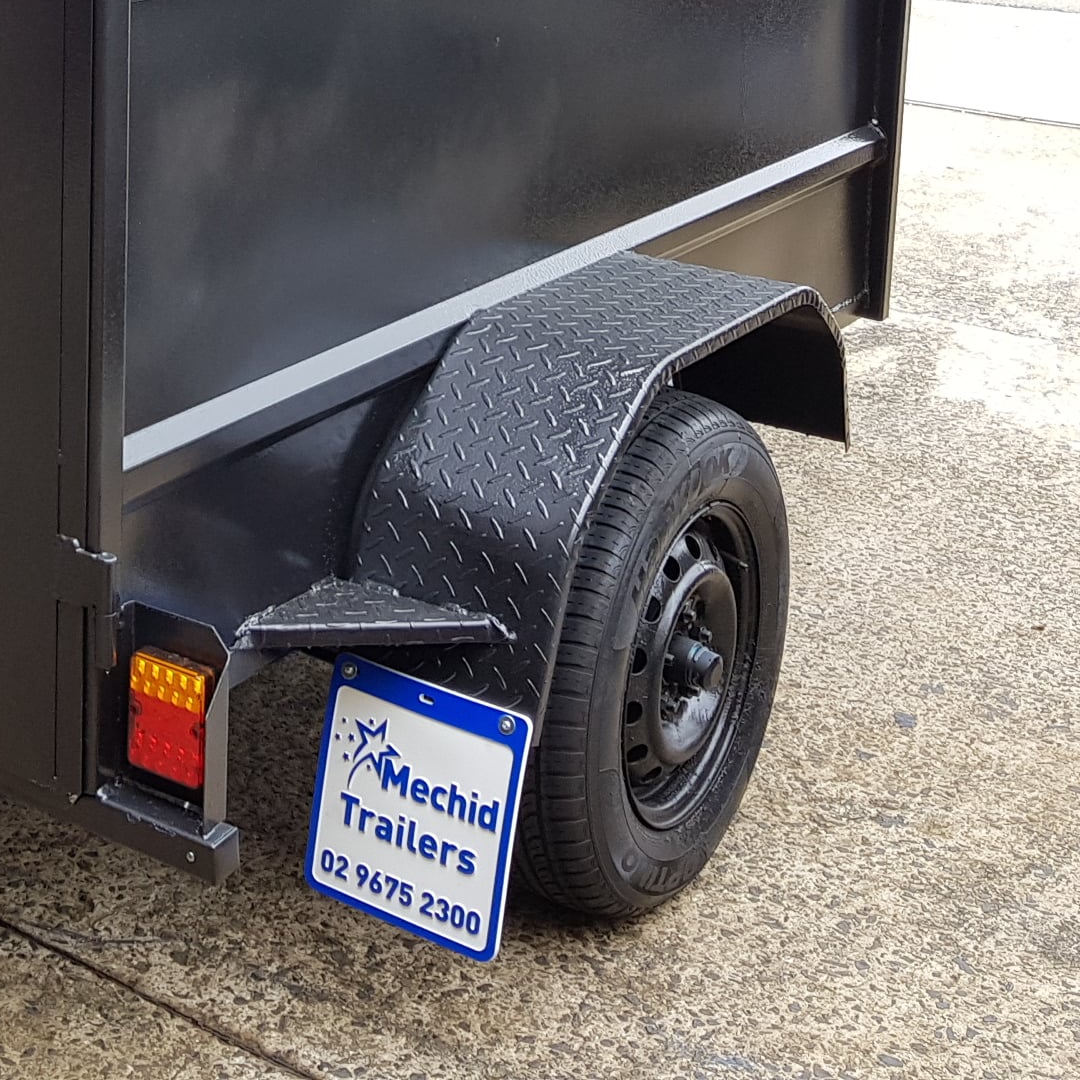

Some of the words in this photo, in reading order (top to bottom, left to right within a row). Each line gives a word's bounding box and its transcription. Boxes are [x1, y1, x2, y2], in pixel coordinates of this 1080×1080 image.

[340, 792, 477, 875] Trailers
[381, 758, 500, 834] Mechid
[320, 849, 349, 882] 02
[356, 864, 414, 907] 9675
[419, 891, 481, 936] 2300
